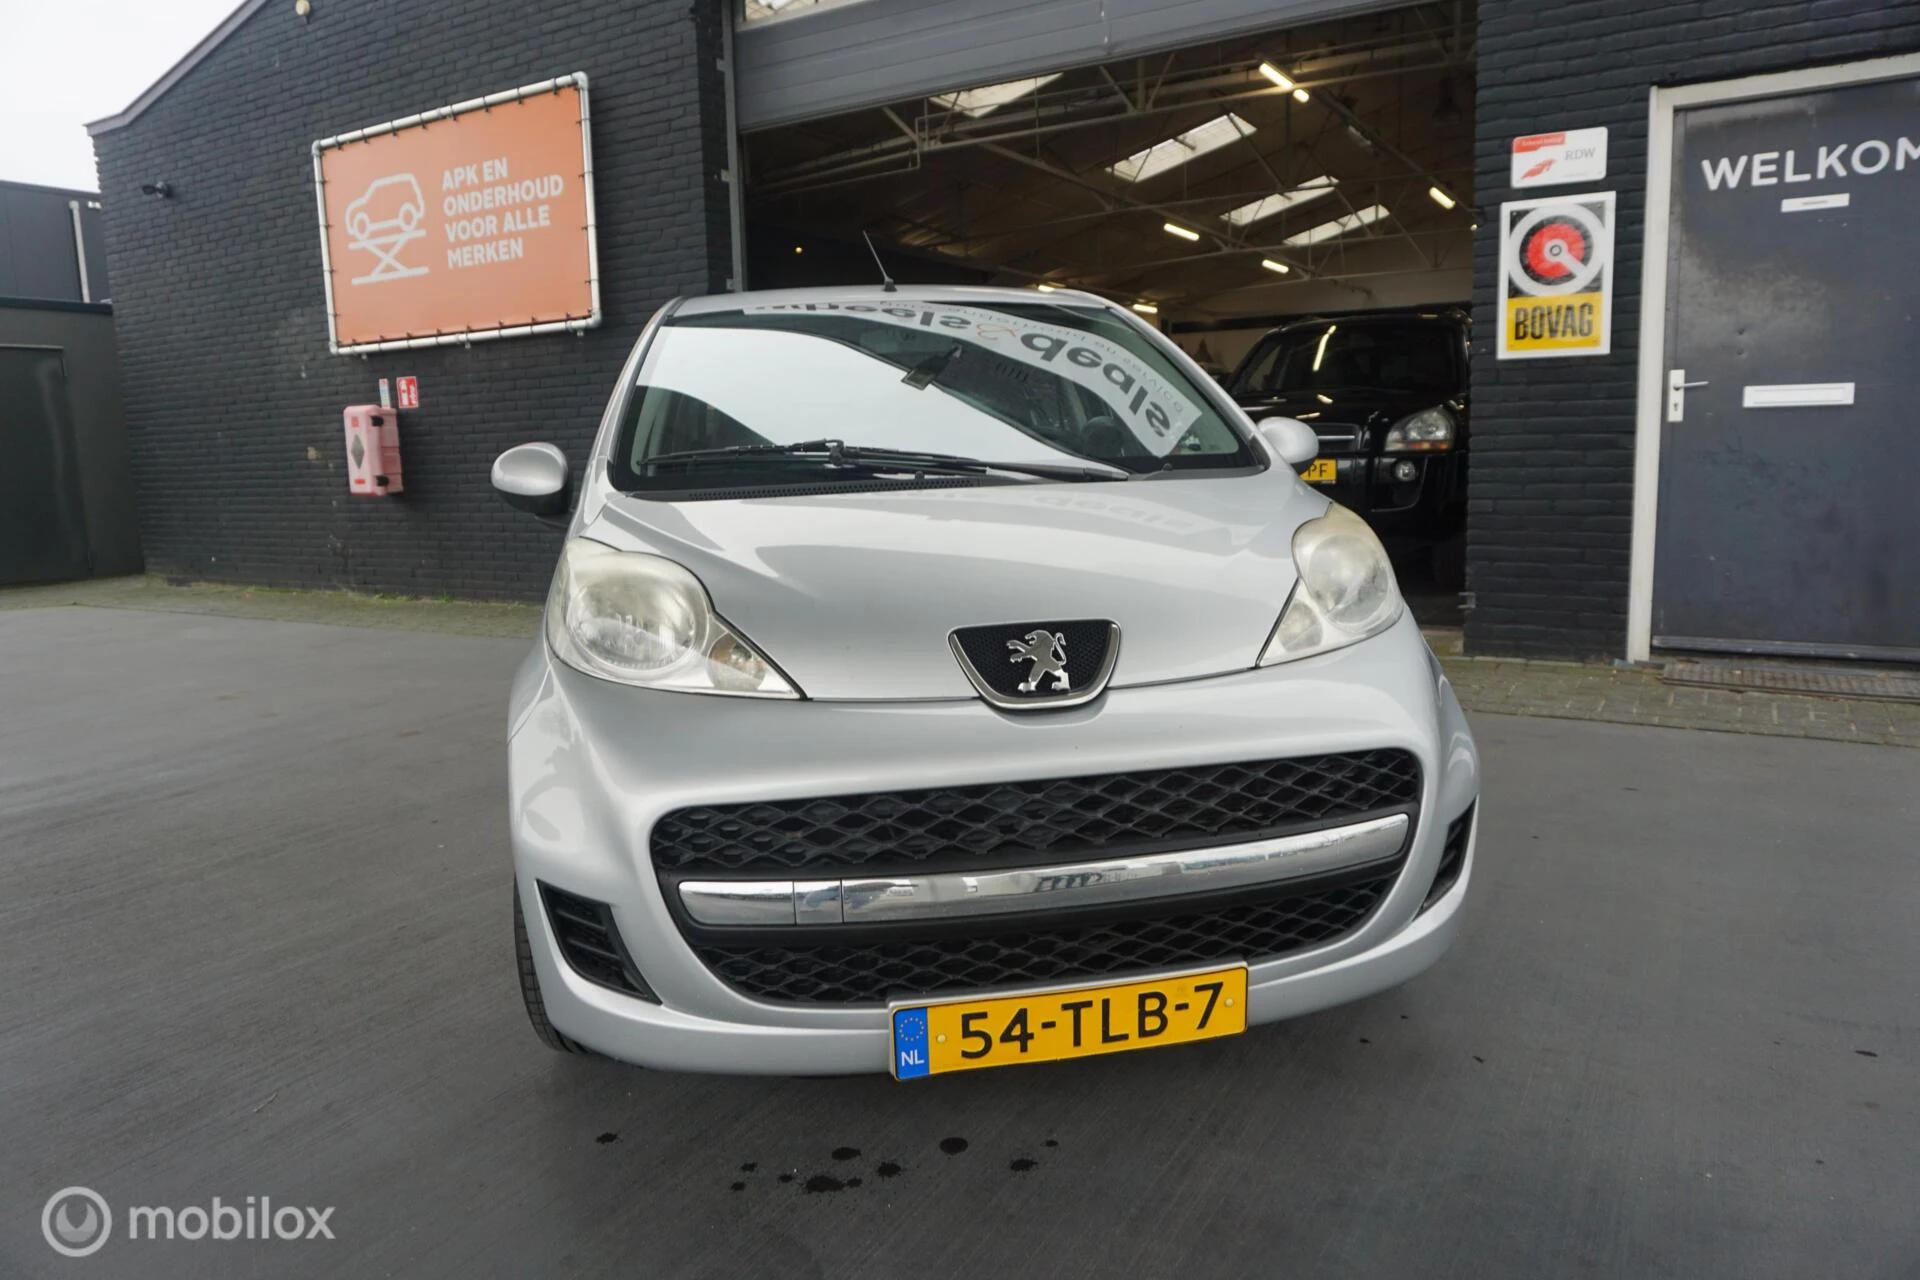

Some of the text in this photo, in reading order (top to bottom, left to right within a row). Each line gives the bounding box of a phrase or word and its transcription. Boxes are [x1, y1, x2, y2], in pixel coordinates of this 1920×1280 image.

[1564, 147, 1596, 161] RDW
[1701, 136, 1920, 191] WELKOM
[442, 157, 508, 191] APK EN
[443, 175, 564, 217] ONDERHOUD
[445, 205, 550, 242] VOOR ALLE
[447, 238, 523, 269] MERKEN
[1514, 302, 1593, 341] BOVAG
[960, 982, 1224, 1059] 54-TLB-7
[901, 1050, 924, 1067] NL
